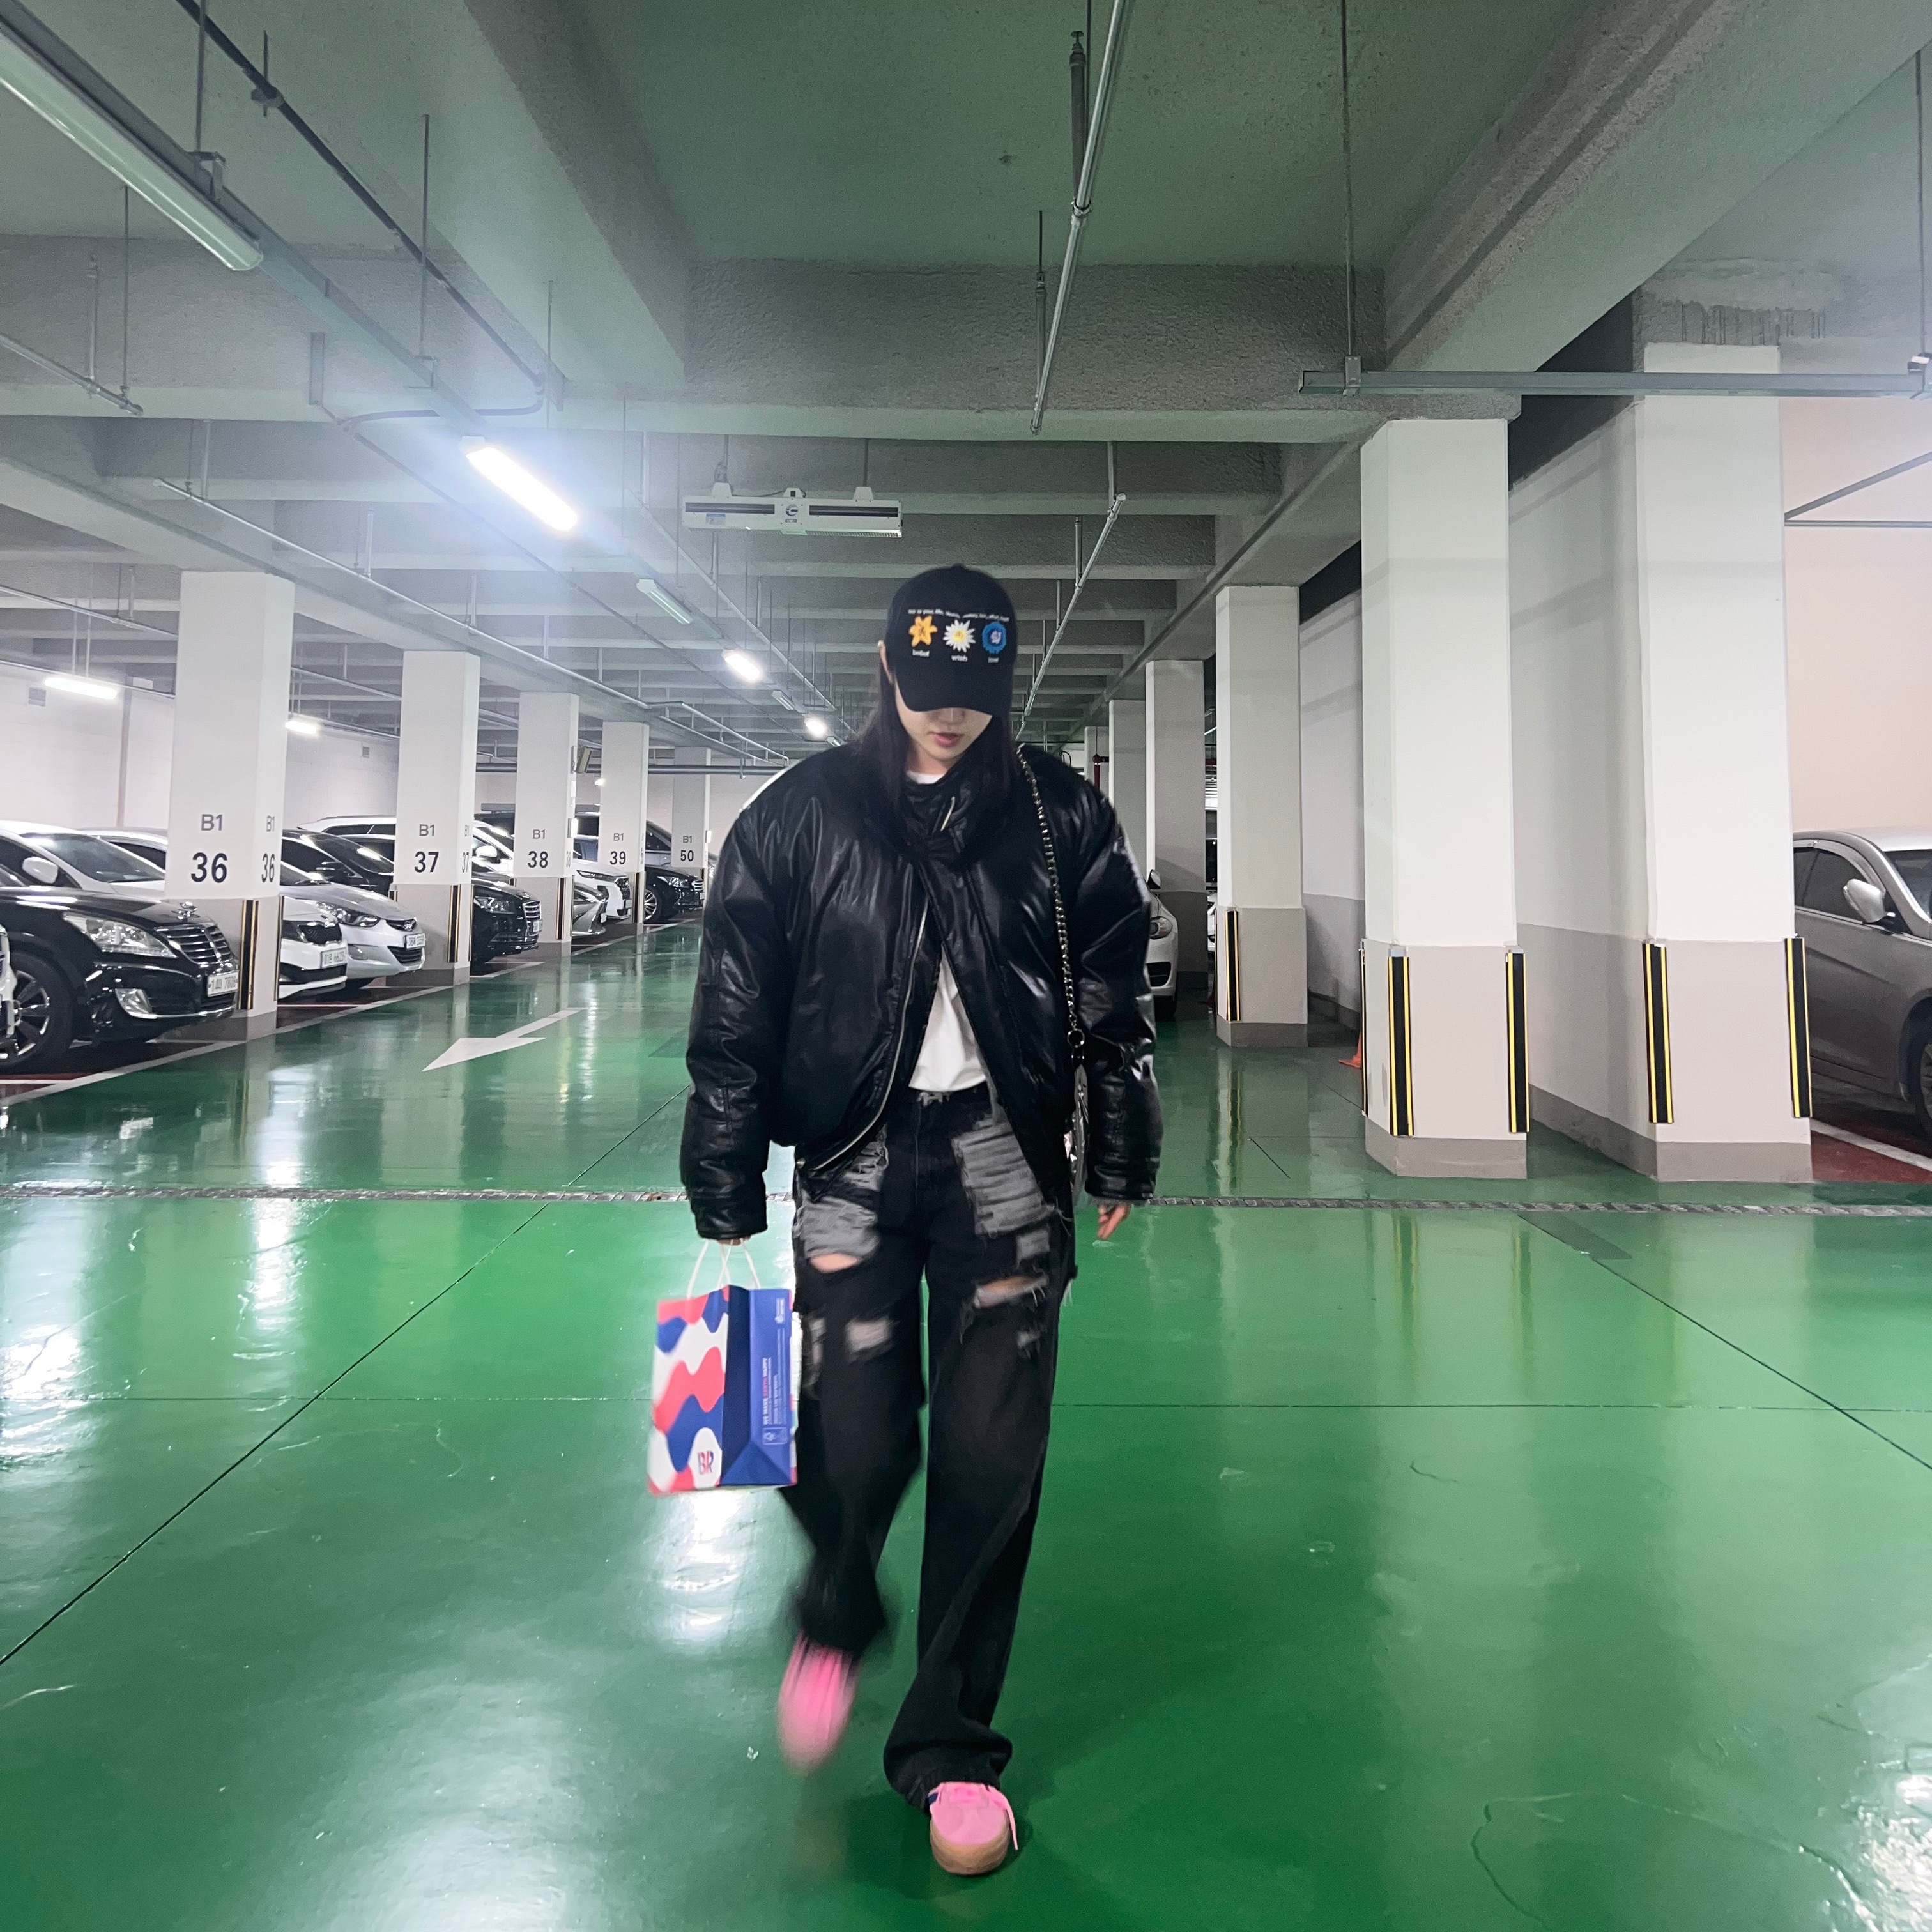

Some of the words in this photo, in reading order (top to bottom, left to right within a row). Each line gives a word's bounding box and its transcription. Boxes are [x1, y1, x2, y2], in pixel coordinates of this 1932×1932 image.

[201, 813, 224, 831] B1
[266, 815, 275, 832] B1
[419, 824, 435, 836] B1
[532, 829, 546, 839] B1
[613, 832, 624, 841] B1
[682, 835, 693, 843] B1
[414, 851, 439, 873] 37
[528, 850, 549, 868] 38
[610, 850, 627, 865] 39
[680, 850, 694, 862] 50
[190, 852, 228, 884] 36
[261, 852, 275, 883] 36
[698, 1450, 714, 1475] BR
